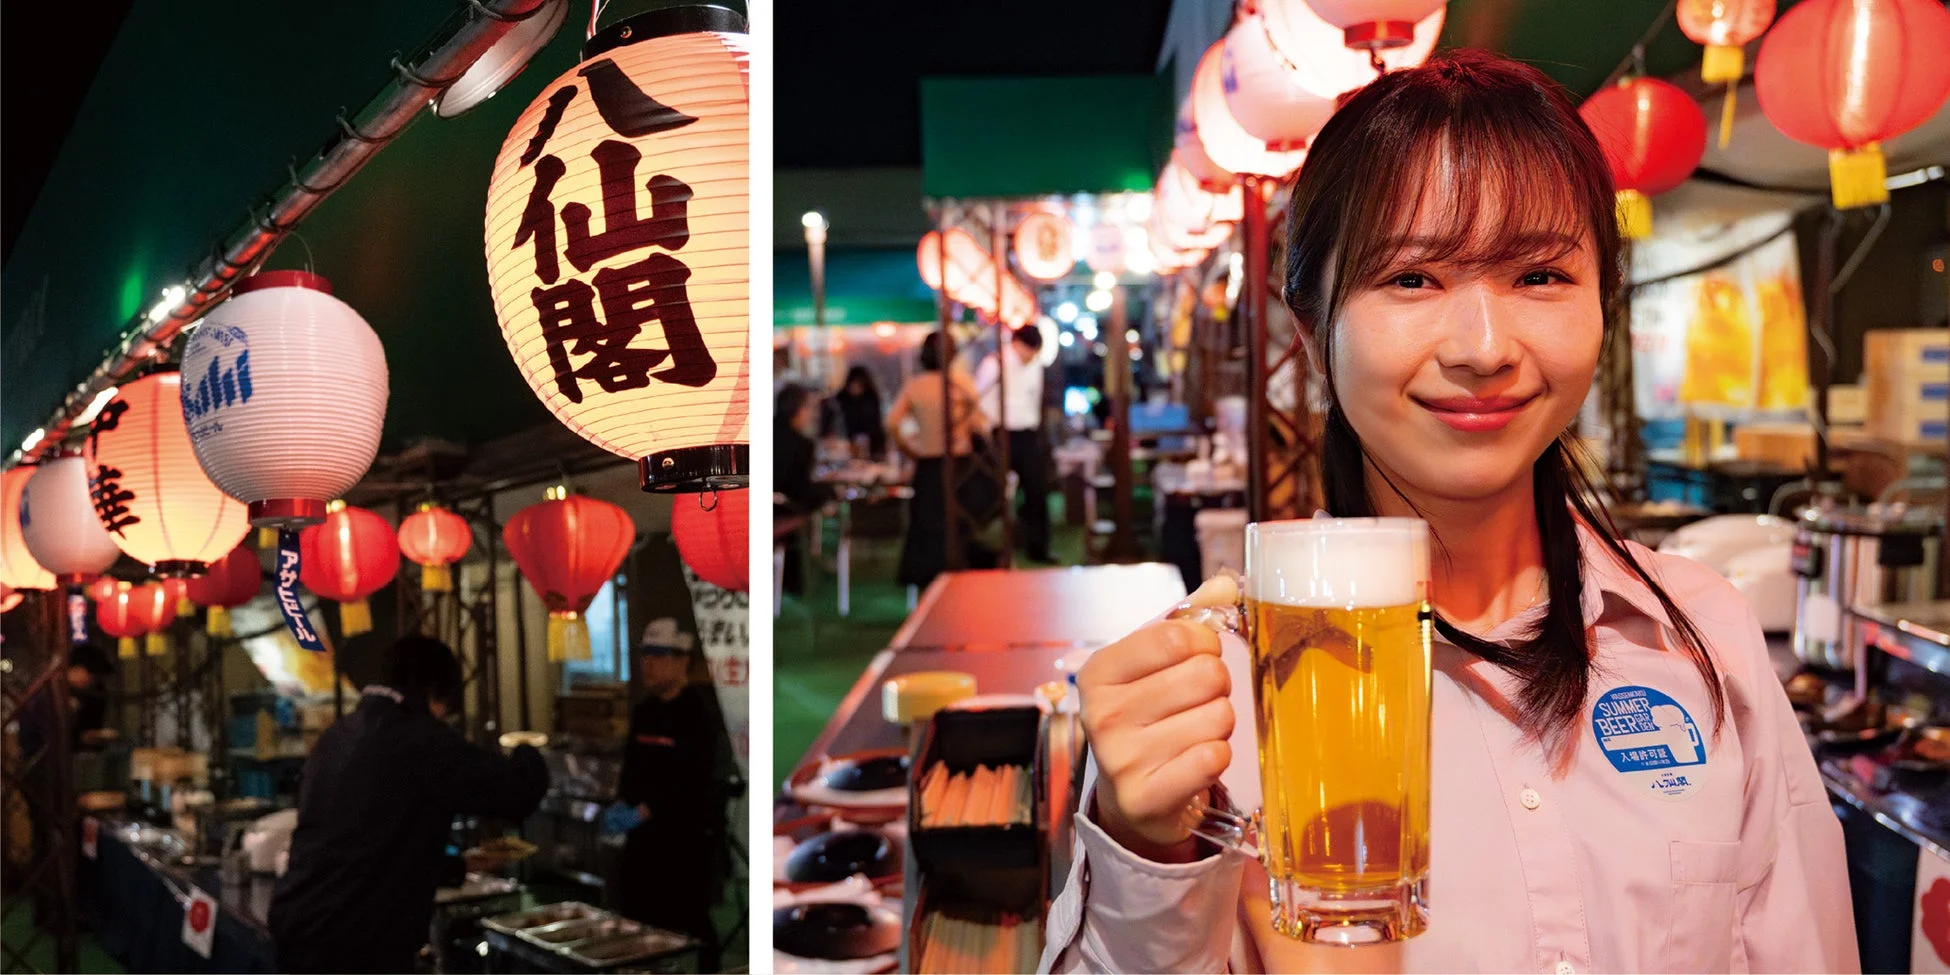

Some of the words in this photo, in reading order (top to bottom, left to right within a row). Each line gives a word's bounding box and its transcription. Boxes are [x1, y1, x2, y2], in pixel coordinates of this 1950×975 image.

[511, 58, 718, 404] 八仙閣
[278, 548, 317, 643] アサヒビール
[1598, 697, 1651, 717] SUMMER
[1595, 715, 1641, 735] BEER
[1633, 713, 1651, 723] GAR
